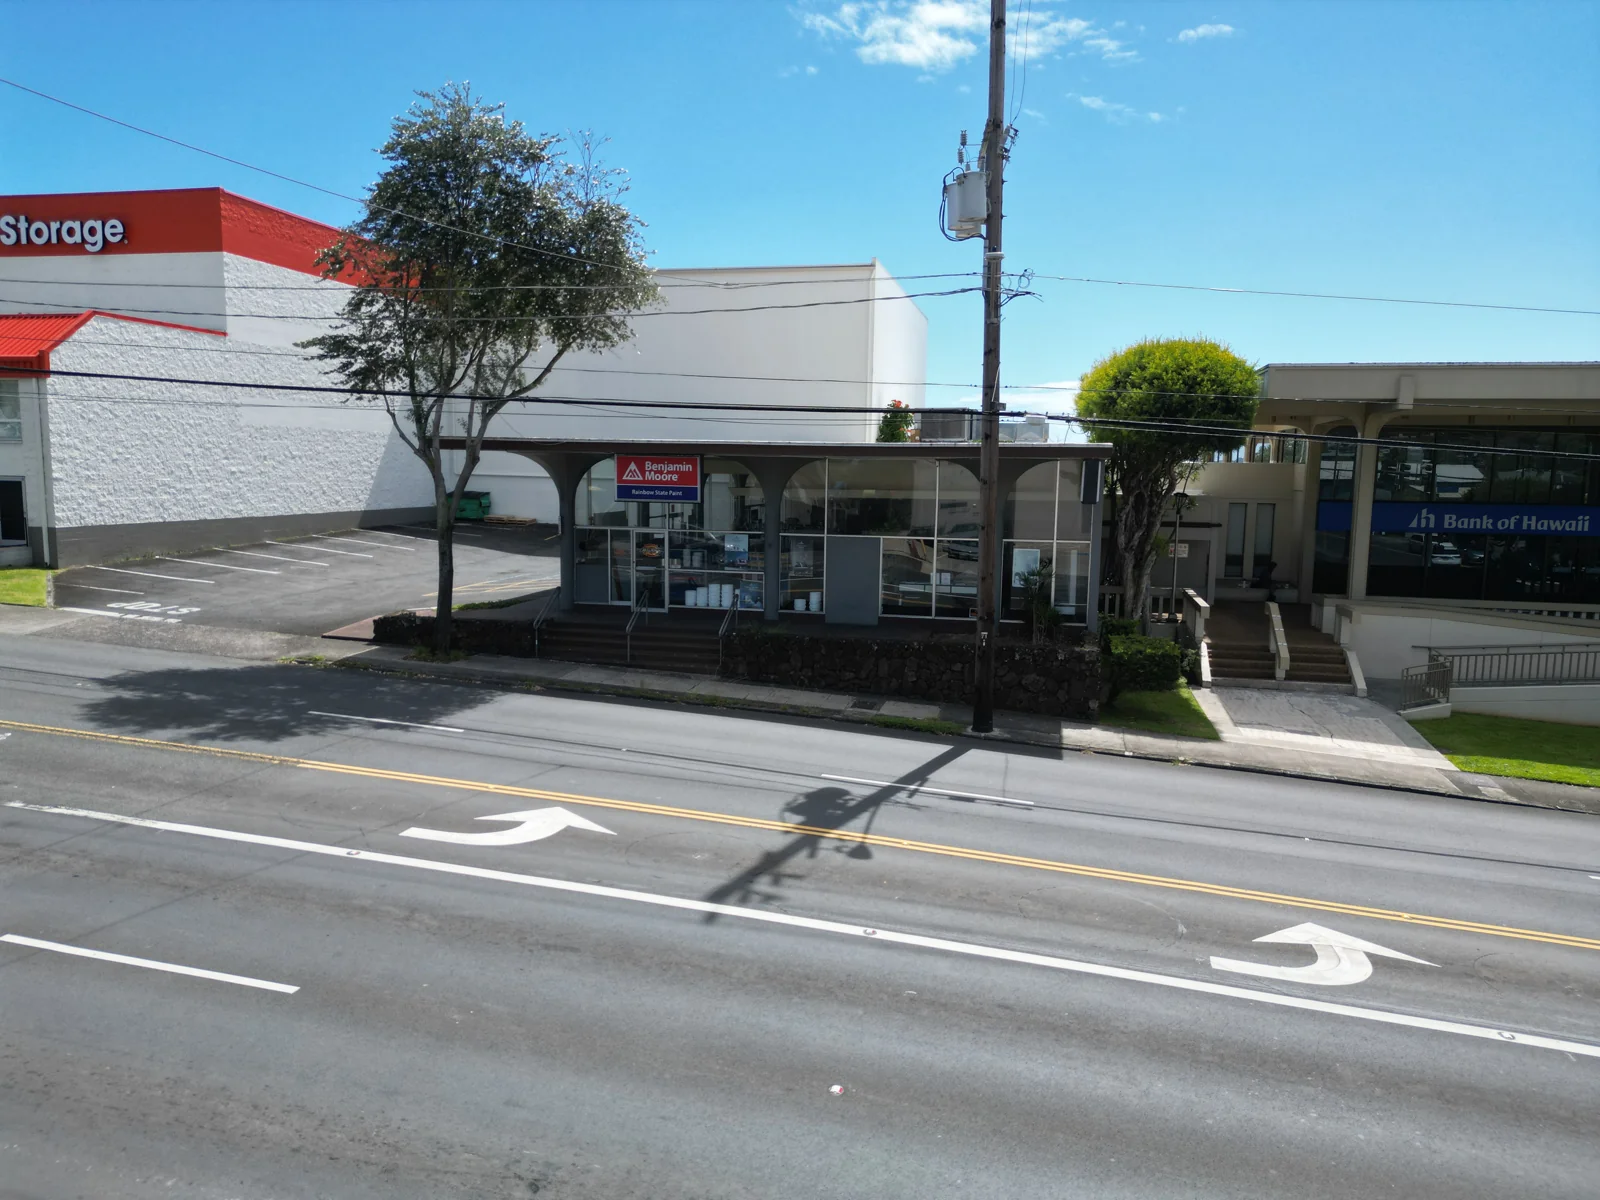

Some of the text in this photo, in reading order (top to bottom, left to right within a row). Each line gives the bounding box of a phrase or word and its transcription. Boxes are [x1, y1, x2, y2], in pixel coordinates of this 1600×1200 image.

[0, 215, 124, 252] Storage
[645, 461, 693, 474] Benjamin
[645, 471, 678, 481] Moore
[1443, 514, 1590, 532] Bank of Hawaii
[106, 601, 201, 614] STOP
